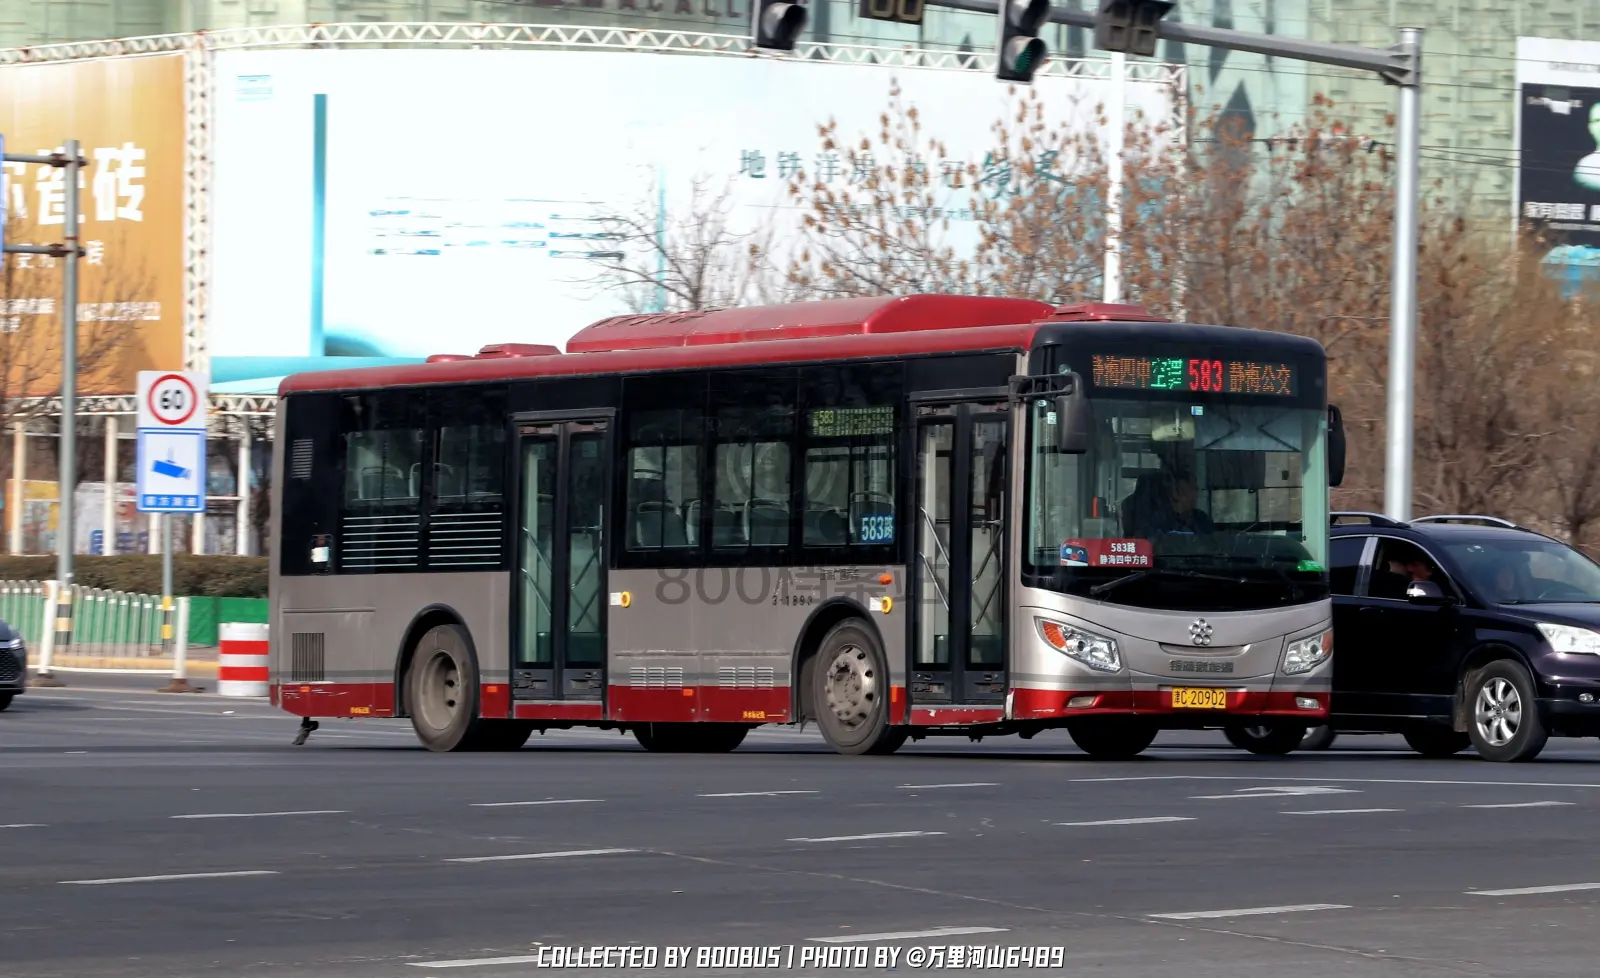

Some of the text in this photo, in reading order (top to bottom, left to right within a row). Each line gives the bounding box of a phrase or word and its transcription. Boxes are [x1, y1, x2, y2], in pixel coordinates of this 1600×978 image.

[1188, 359, 1223, 392] 583
[161, 389, 185, 410] 60
[862, 515, 893, 540] 583路
[1111, 543, 1136, 553] 583路
[1100, 554, 1148, 565] 静海四中方向
